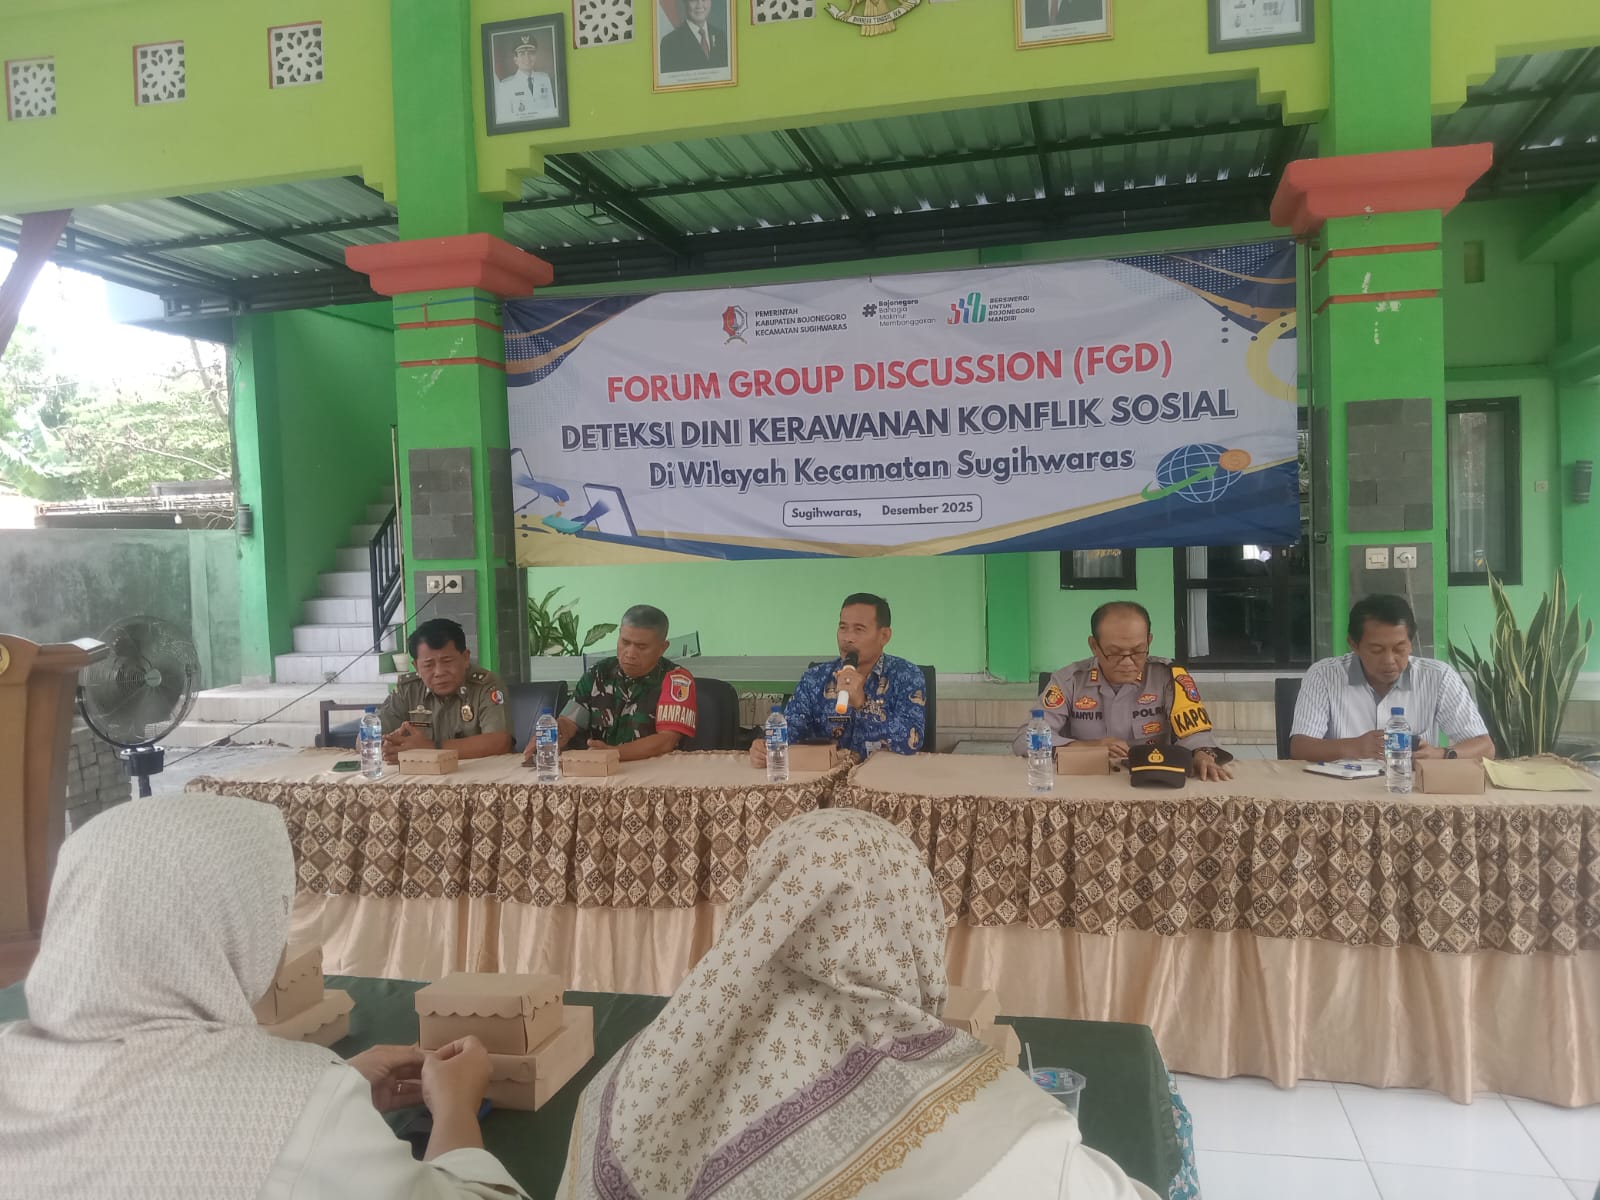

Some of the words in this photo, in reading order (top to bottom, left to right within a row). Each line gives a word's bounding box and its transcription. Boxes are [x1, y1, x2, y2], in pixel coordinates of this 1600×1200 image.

[755, 308, 798, 318] PEMERINTAH
[756, 318, 796, 327] KABUPATEN
[797, 313, 847, 324] BOJONEGORO
[756, 327, 798, 337] KECAMATAN
[800, 323, 847, 334] SUGIHWARAS
[607, 372, 721, 403] FORUM
[728, 364, 845, 398] GROUP
[853, 349, 1062, 392] DISCUSSION
[1073, 339, 1173, 385] (FGD)
[561, 421, 674, 451] DETEKSI
[681, 418, 742, 448] DINI
[749, 407, 950, 444] KERAWANAN
[957, 397, 1104, 435] KONFLIK
[1109, 388, 1238, 425] SOSIAL
[649, 462, 674, 488] Di
[678, 457, 787, 493] Wilayah
[794, 457, 950, 486] Kecamatan
[957, 446, 1135, 483] Sugihwaras
[791, 508, 862, 521] Sugihwaras,
[882, 504, 938, 515] Desember
[942, 502, 974, 513] 2025
